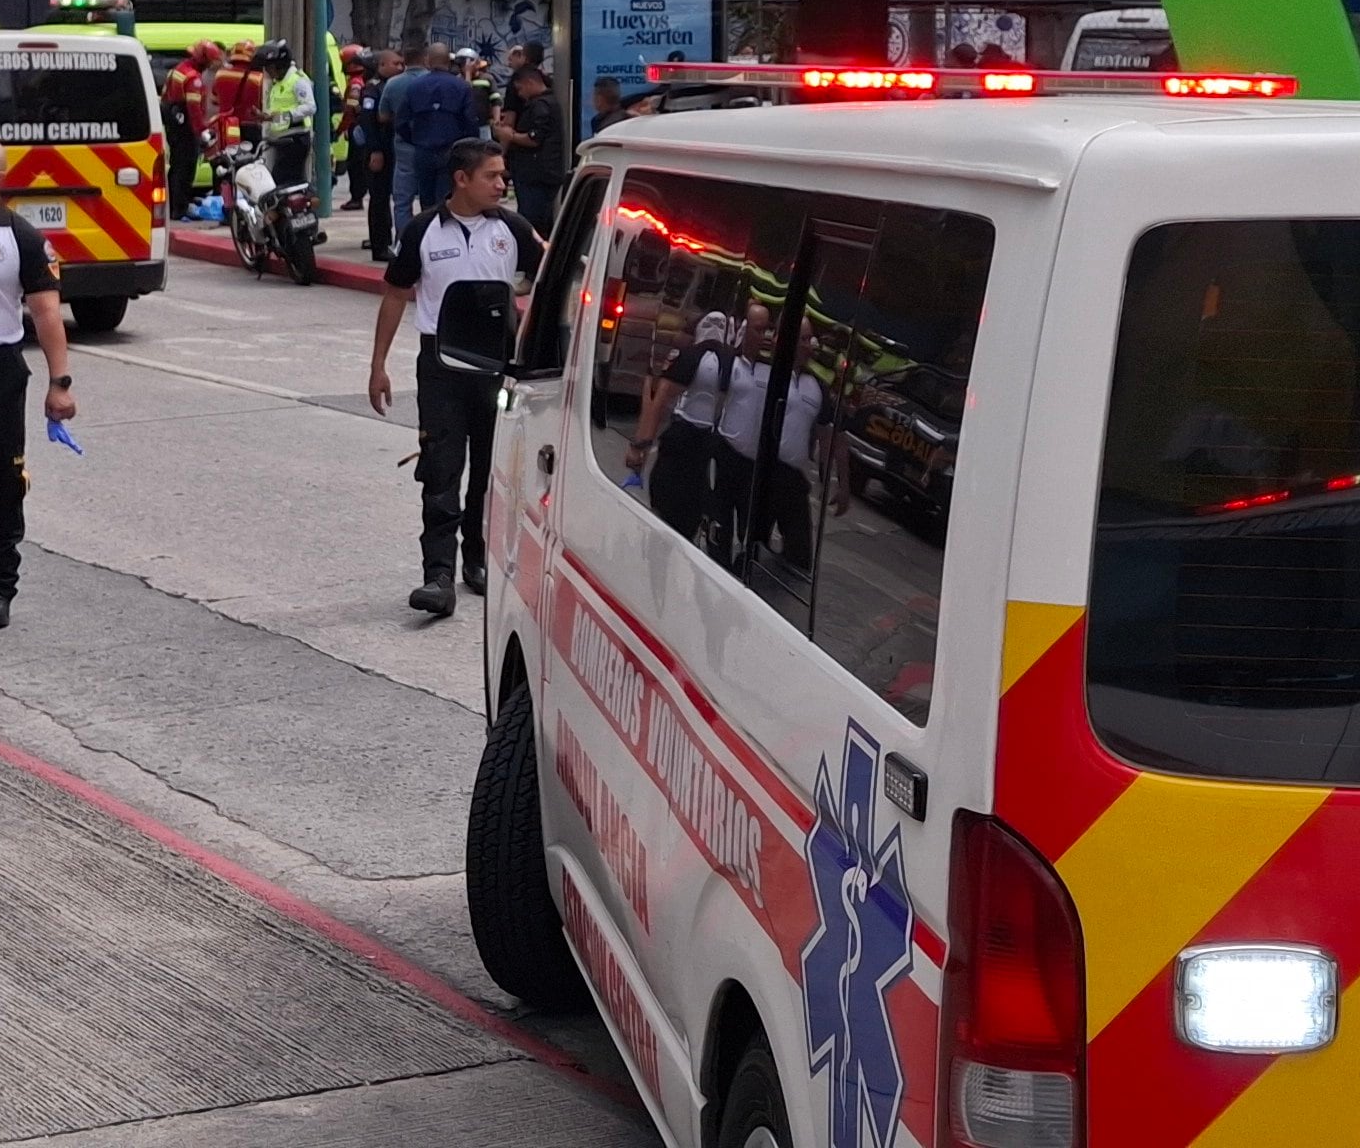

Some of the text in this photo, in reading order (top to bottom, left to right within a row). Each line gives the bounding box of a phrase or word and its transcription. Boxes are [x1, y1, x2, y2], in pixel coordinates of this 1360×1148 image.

[632, 1, 664, 10] NUEVOS
[602, 10, 669, 30] Huevos
[31, 53, 117, 71] VOLUNTARIOS
[47, 122, 120, 139] CENTRAL
[39, 208, 62, 222] 1620
[571, 601, 765, 910] BOMBEROS VOLUNTARIOS
